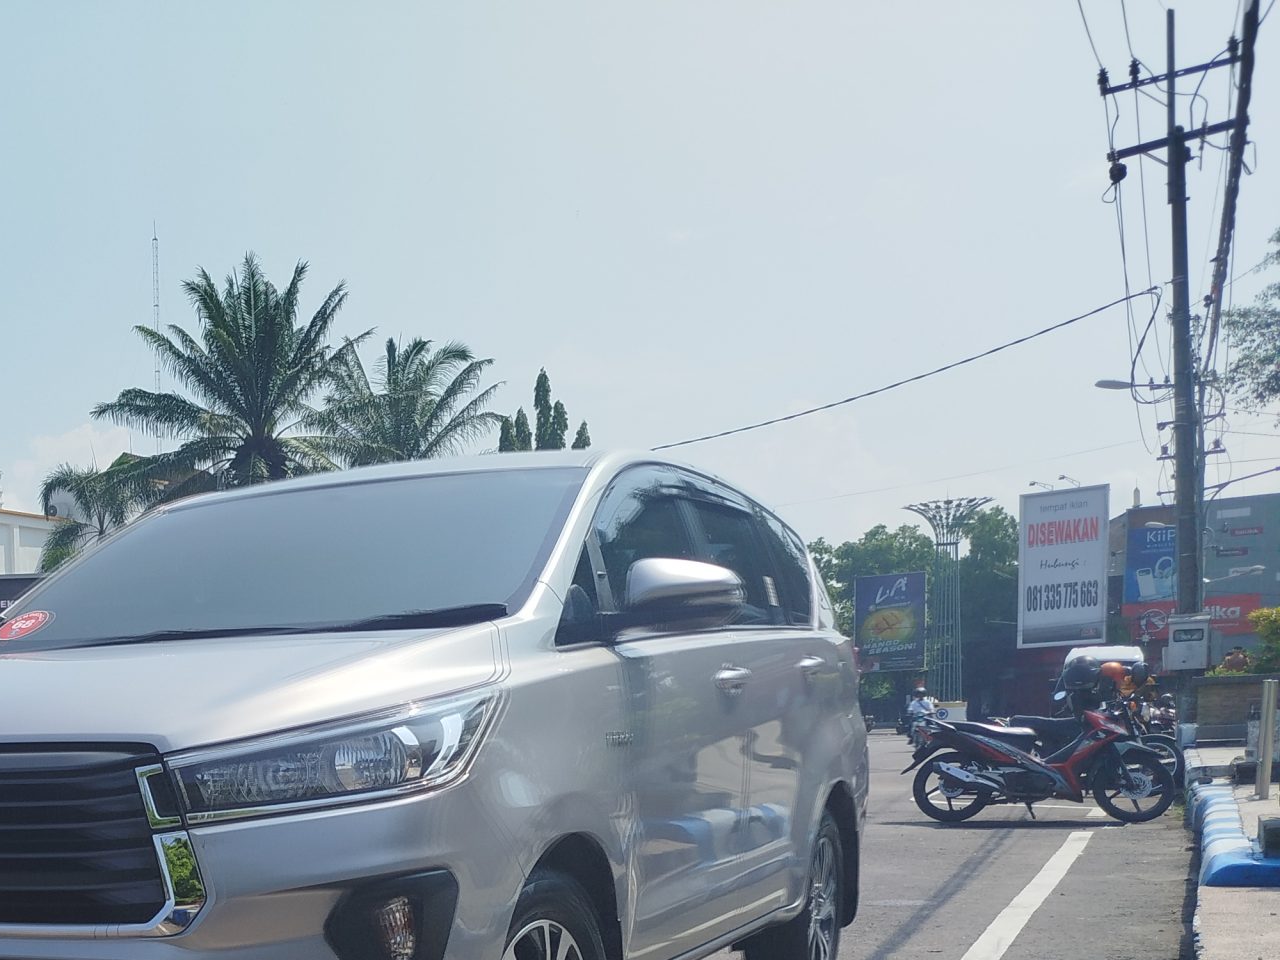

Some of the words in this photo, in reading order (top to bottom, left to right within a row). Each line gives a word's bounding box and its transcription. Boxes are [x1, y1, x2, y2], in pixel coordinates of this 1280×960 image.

[1040, 502, 1067, 512] tempat
[1070, 500, 1088, 509] iklan
[1027, 516, 1098, 548] DISEWAKAN
[1040, 558, 1079, 570] Hubungi
[1026, 585, 1042, 612] 081
[1044, 583, 1061, 610] 335
[1063, 581, 1078, 608] 775
[1080, 580, 1098, 607] 663
[864, 640, 900, 649] MANGO
